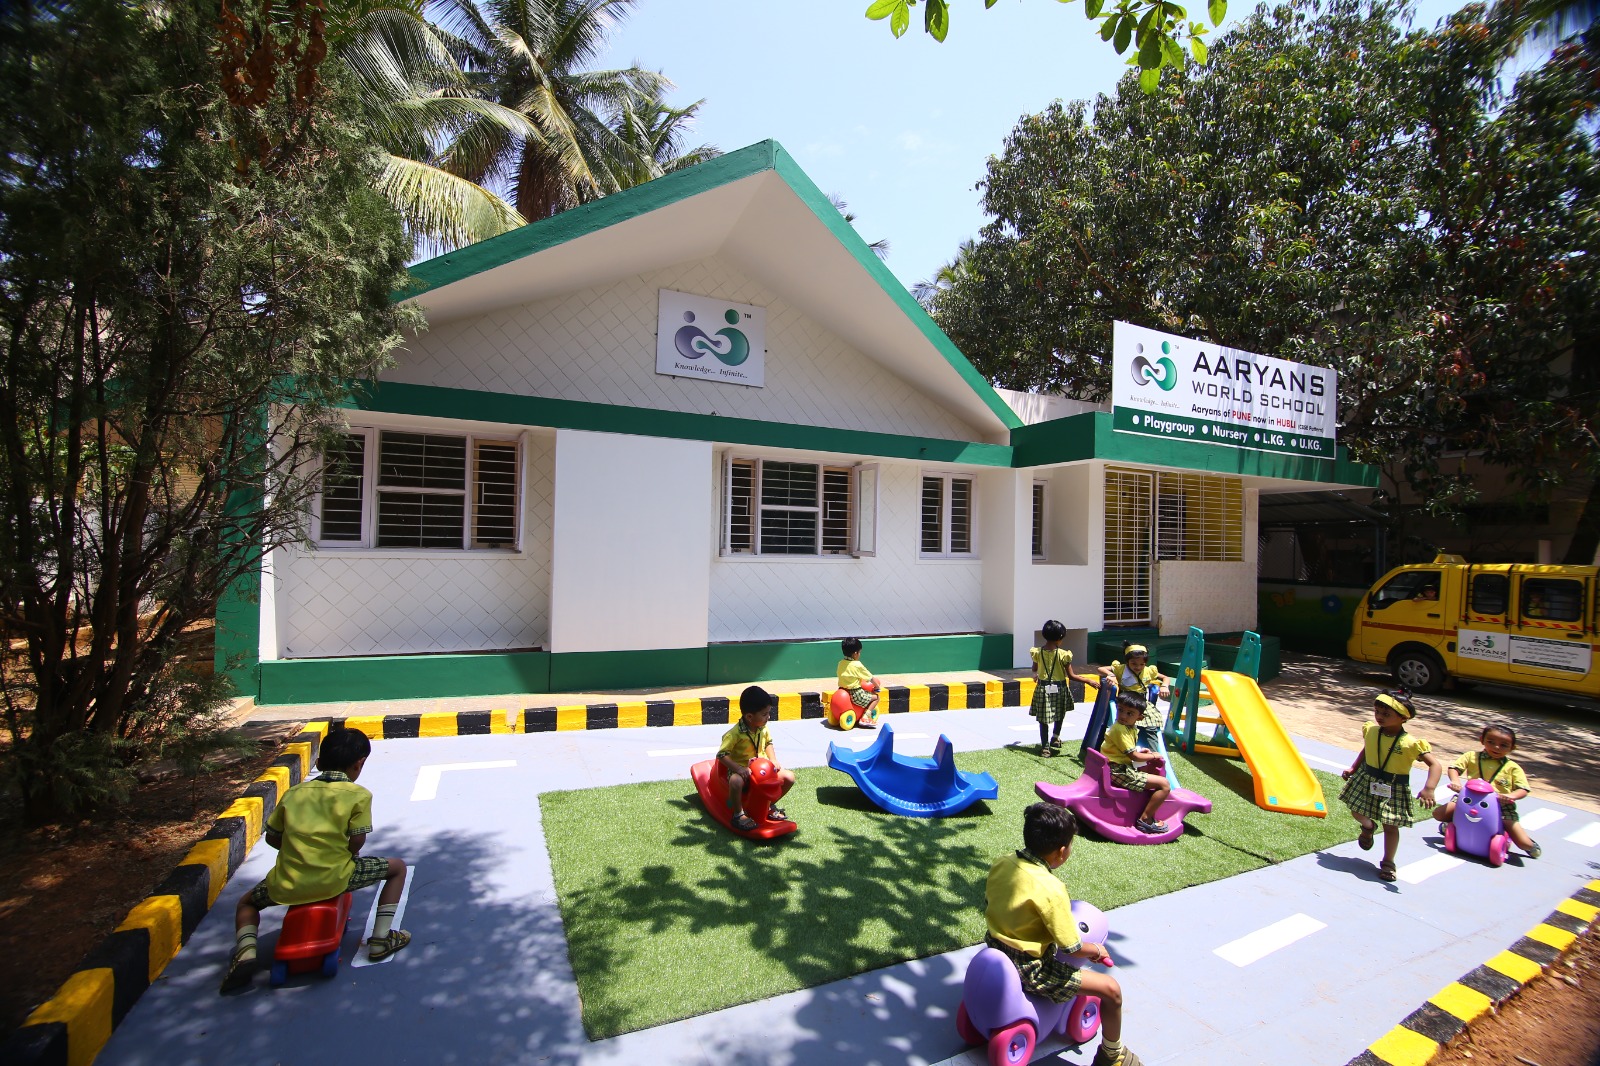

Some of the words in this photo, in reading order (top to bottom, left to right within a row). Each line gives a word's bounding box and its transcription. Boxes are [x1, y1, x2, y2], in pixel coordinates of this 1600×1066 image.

[1192, 351, 1325, 397] AARYANS
[1191, 380, 1253, 404] WORLD
[1260, 393, 1325, 416] SCHOOL
[1191, 403, 1222, 417] Aaryans
[1223, 408, 1231, 418] of
[1232, 410, 1252, 422] PUNE
[1252, 416, 1267, 424] now
[1268, 416, 1275, 426] in
[1276, 418, 1296, 429] HUBLI
[1144, 414, 1195, 436] Playgroup
[1212, 425, 1248, 443] Nursery
[1262, 432, 1286, 447] L.KG.
[1299, 437, 1323, 451] U.KG.
[1460, 645, 1507, 657] AARYANS
